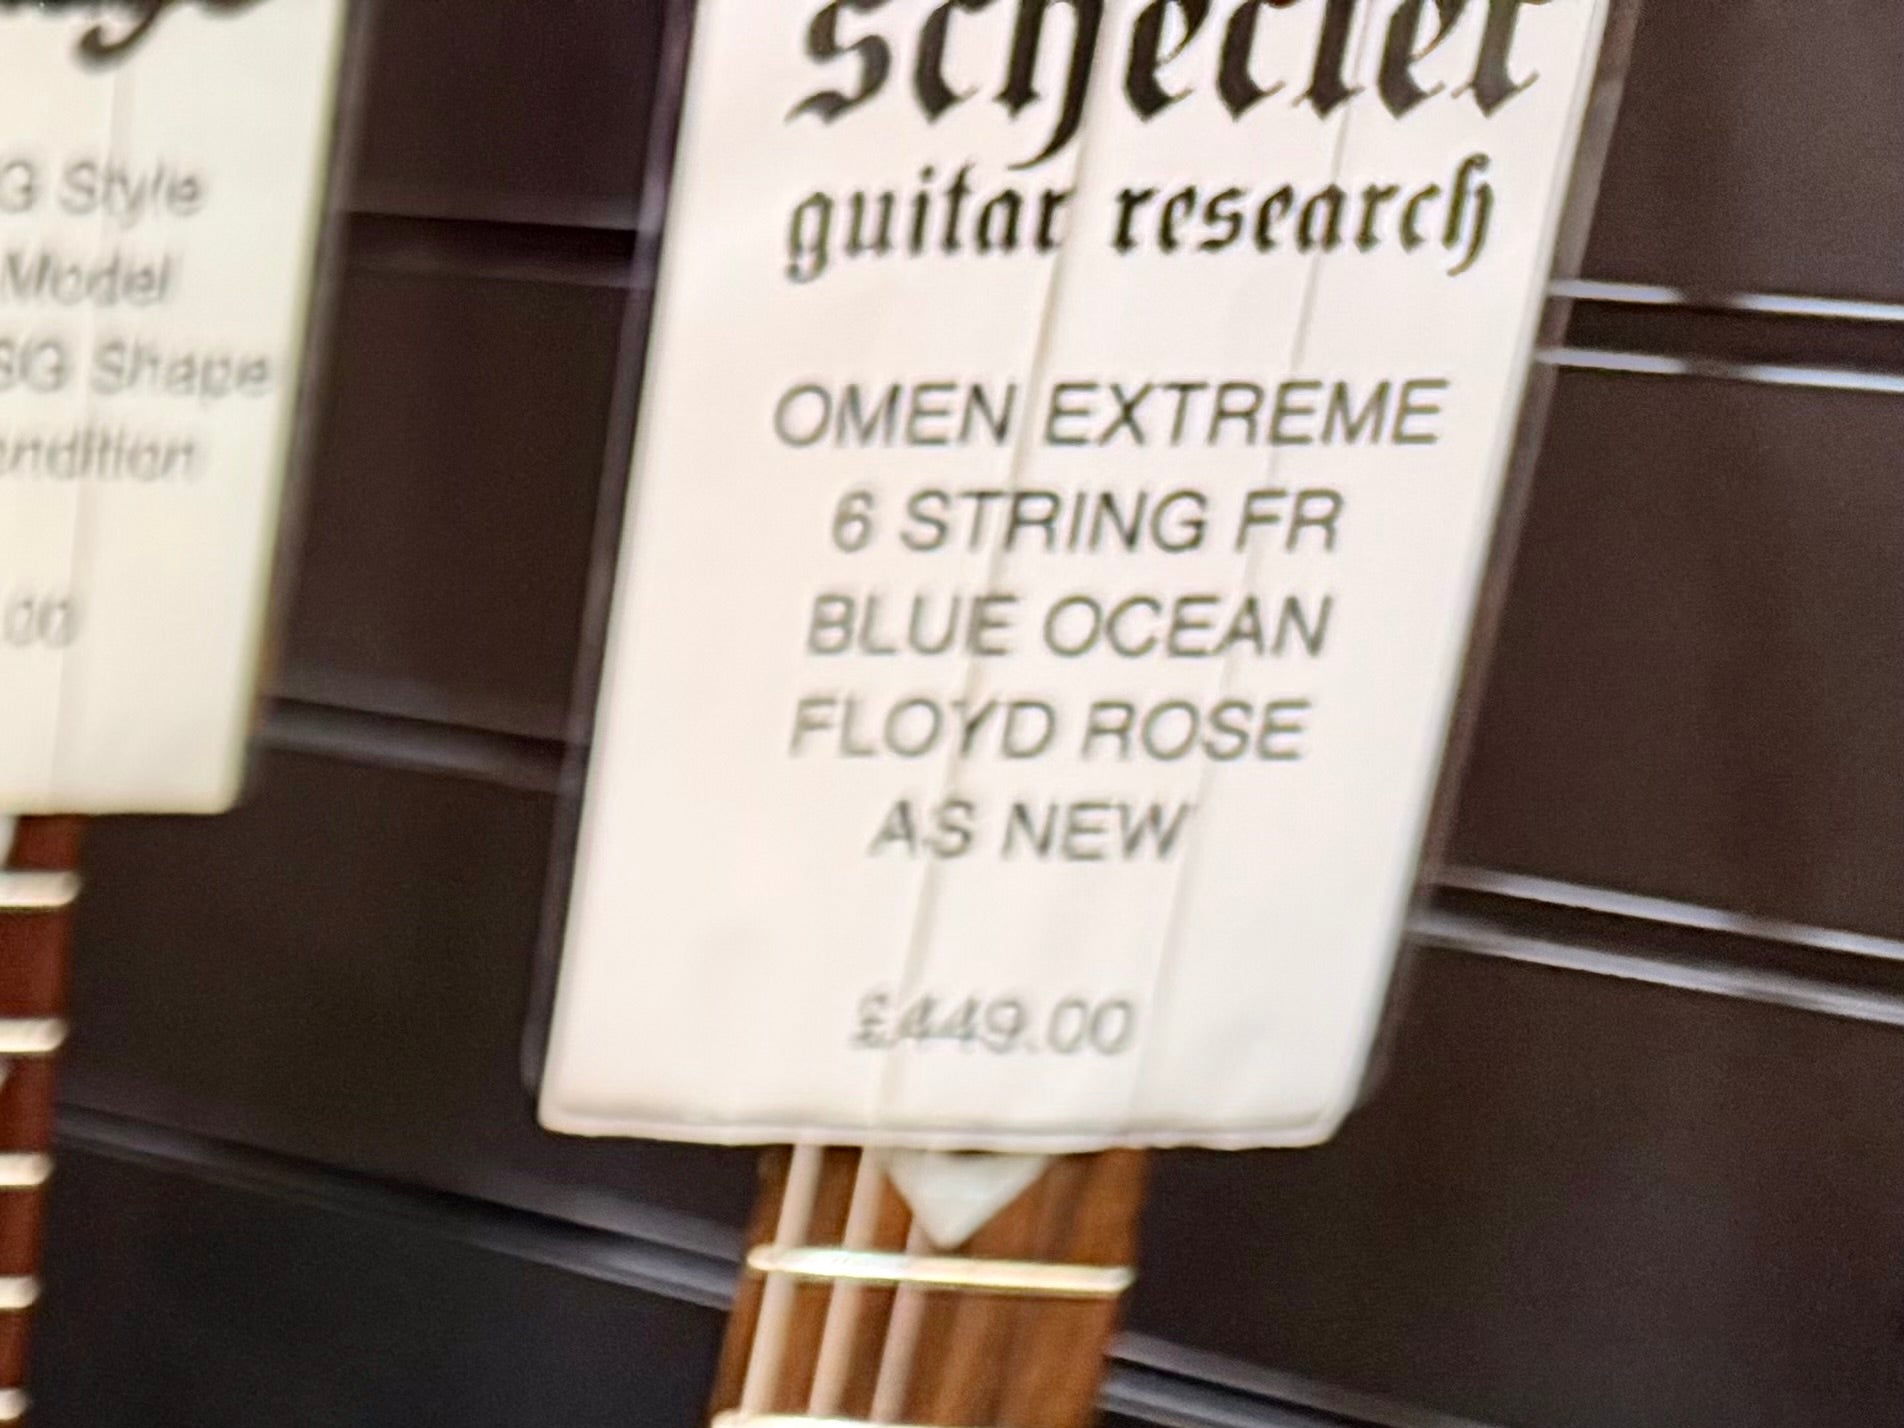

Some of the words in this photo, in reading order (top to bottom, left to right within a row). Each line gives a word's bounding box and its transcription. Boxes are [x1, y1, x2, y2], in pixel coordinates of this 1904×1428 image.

[57, 156, 208, 228] Style
[784, 163, 1072, 283] guitar
[1109, 153, 1493, 277] research
[0, 247, 174, 306] Model
[91, 338, 274, 404] Shape
[773, 381, 1017, 448] OMEN
[1042, 378, 1450, 447] EXTREME
[830, 489, 873, 553] 6
[899, 489, 1210, 553] STRING
[1235, 487, 1345, 553] FR
[805, 593, 1018, 657] BLUE
[1042, 593, 1333, 658] OCEAN
[790, 696, 1059, 760] FLOYD
[1081, 697, 1312, 762] ROSE
[868, 798, 975, 860] AS
[999, 800, 1191, 862] NEW
[849, 992, 1136, 1055] £449.00
